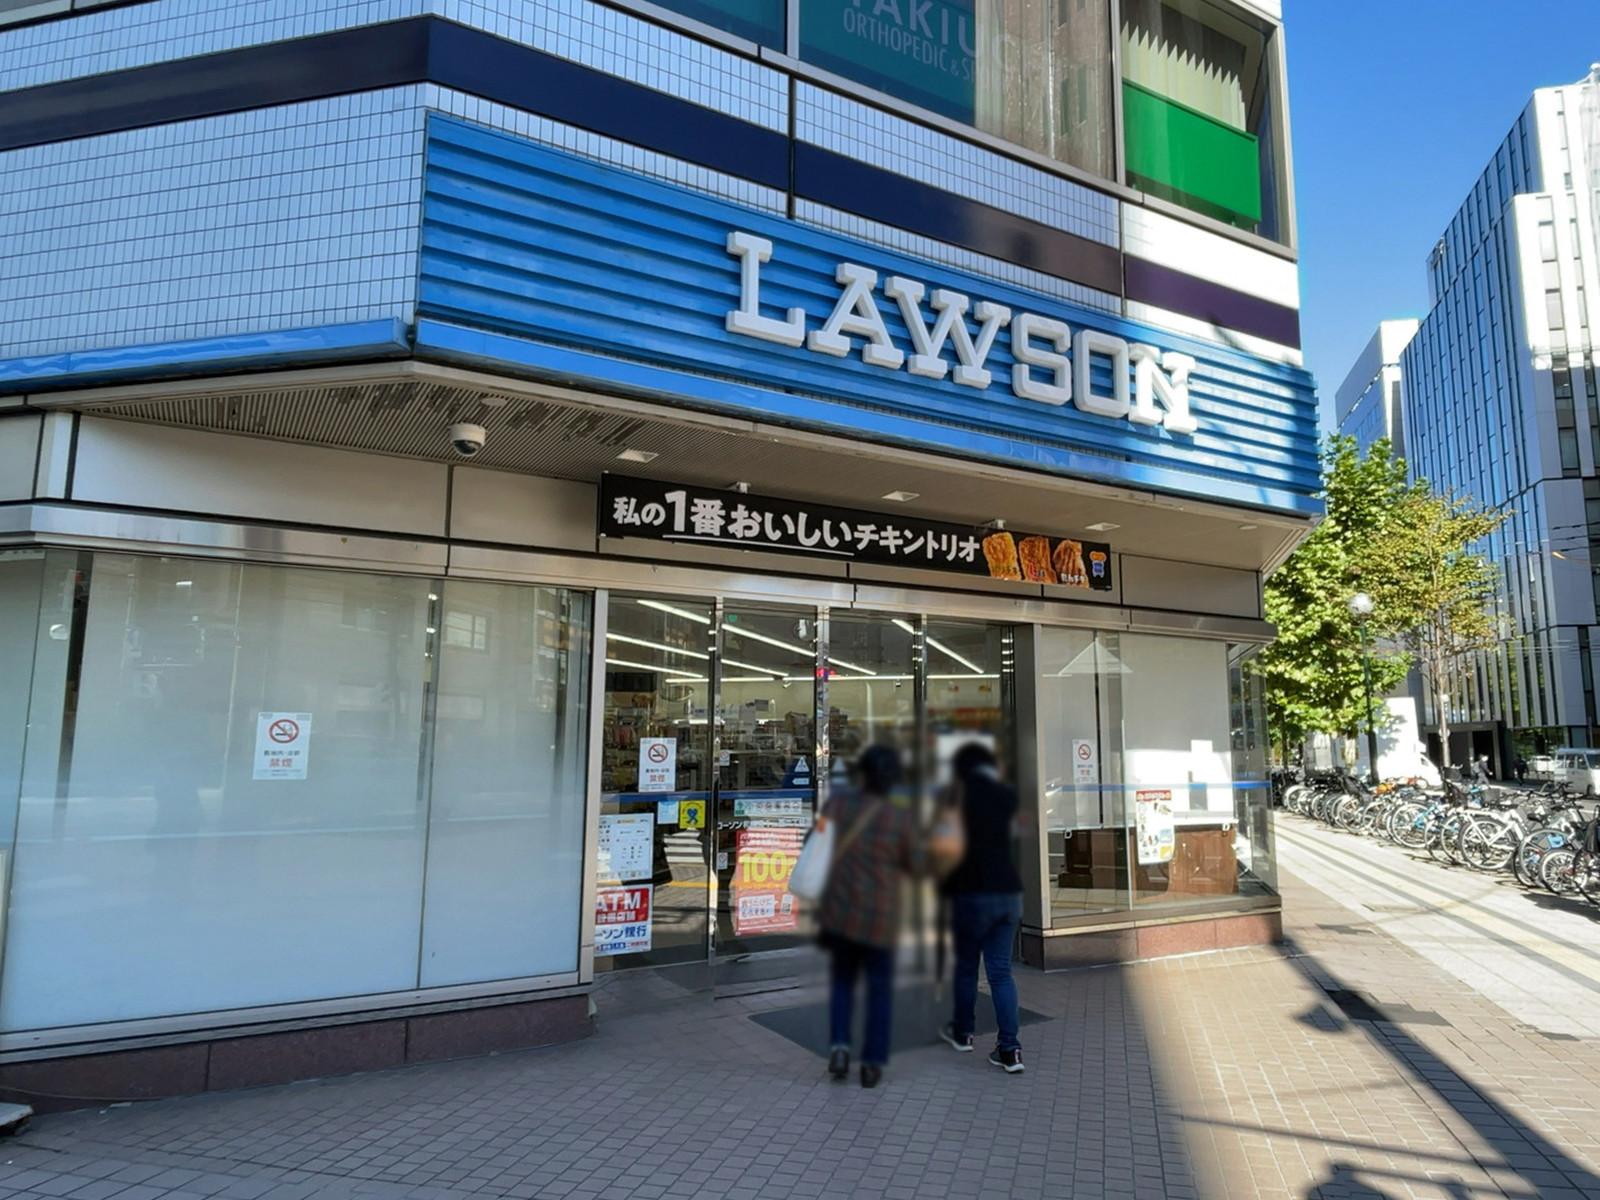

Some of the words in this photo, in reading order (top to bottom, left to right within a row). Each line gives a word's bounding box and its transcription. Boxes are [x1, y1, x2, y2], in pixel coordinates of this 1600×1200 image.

[843, 8, 948, 72] ORTHOPEDIC
[950, 59, 960, 77] &
[852, 0, 976, 57] AKIU
[726, 231, 1198, 434] LAWSON
[613, 490, 981, 563] 私の1番おいしいチキントリオ
[595, 892, 641, 912] ATM
